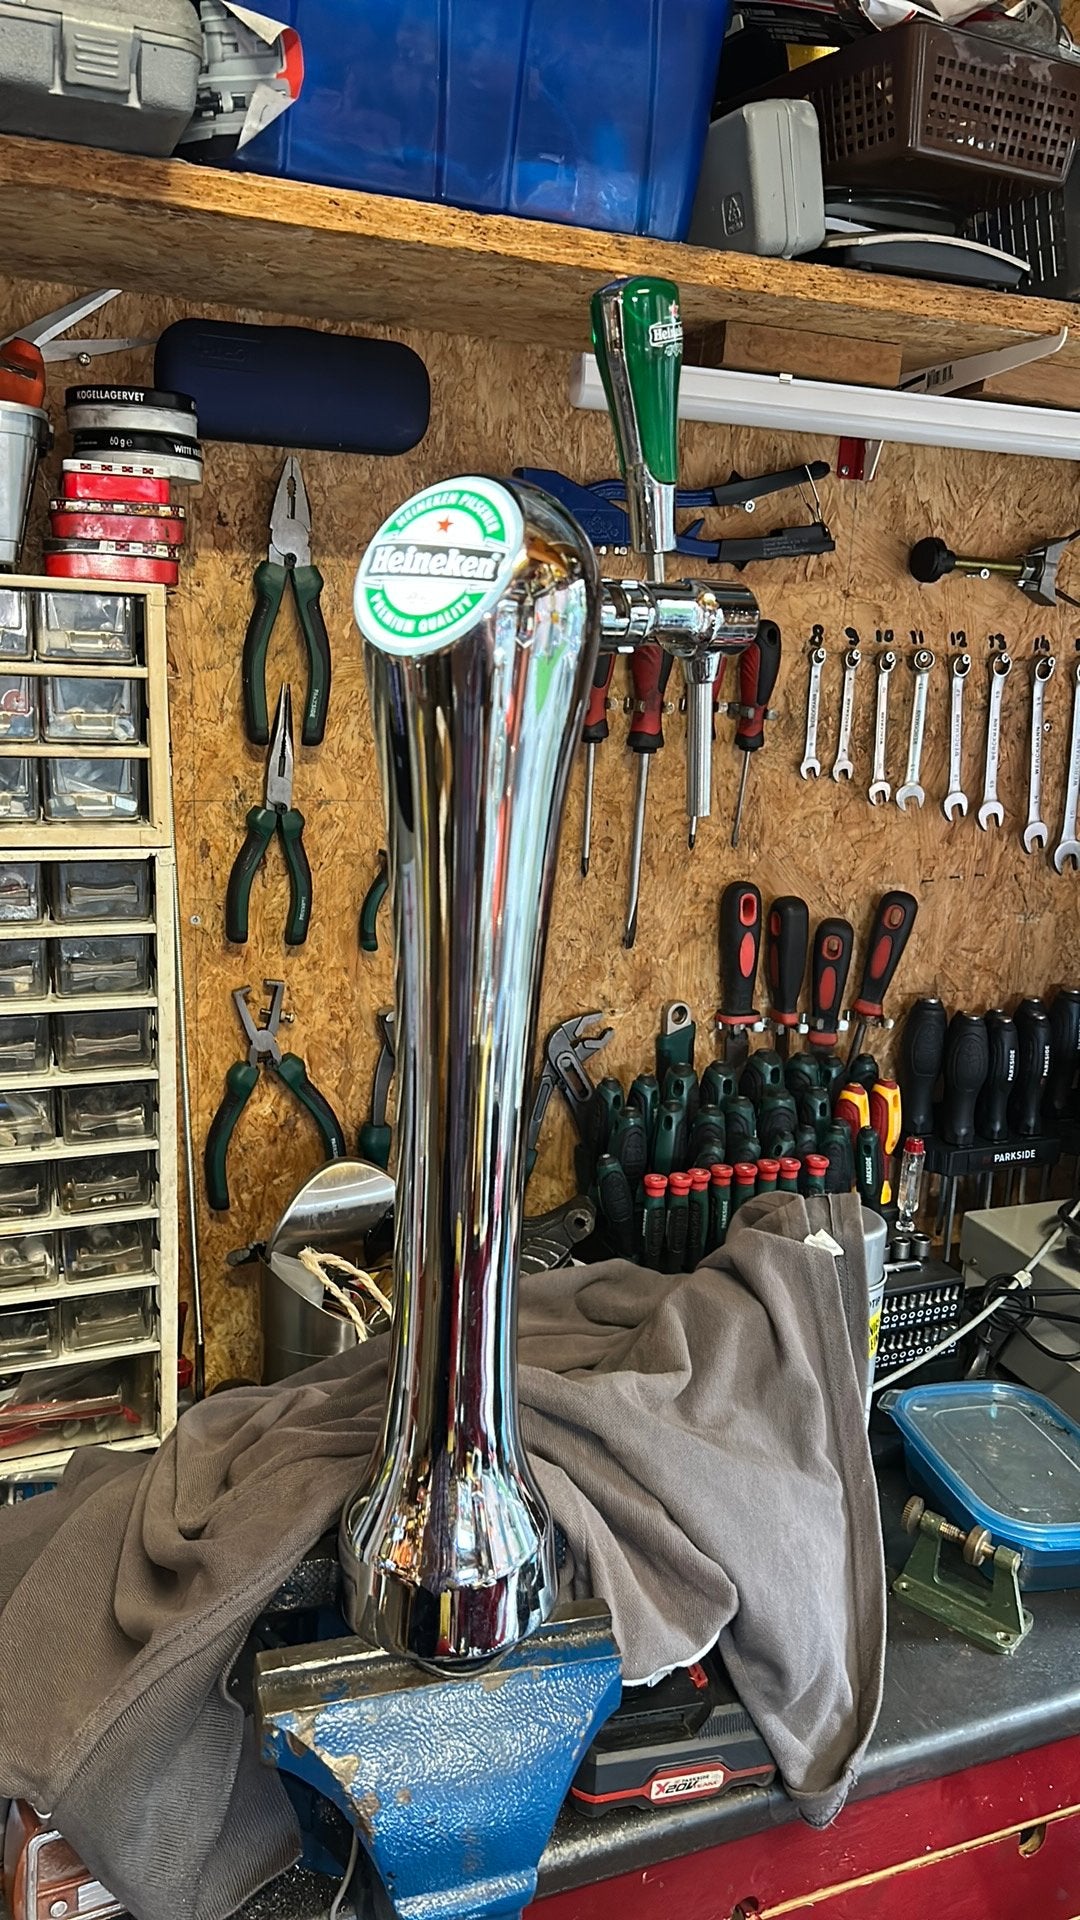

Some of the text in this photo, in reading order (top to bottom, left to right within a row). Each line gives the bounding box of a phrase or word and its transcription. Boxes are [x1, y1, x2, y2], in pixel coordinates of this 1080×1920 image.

[76, 389, 145, 403] KOGELLAGERVET
[109, 436, 119, 446] 60
[369, 544, 498, 580] Heineken
[369, 591, 474, 634] PREMIUM QUALITY
[809, 624, 825, 647] 8
[844, 627, 860, 646] 9
[875, 629, 895, 643] 10
[909, 630, 924, 645] 11
[950, 631, 967, 648] 12
[988, 633, 1007, 650] 13
[1034, 634, 1050, 651] 14
[991, 718, 999, 761] WERCKMANN
[1034, 725, 1042, 774] WERCKMANN
[1007, 1049, 1015, 1082] PARKSIDE
[994, 1149, 1036, 1163] PARKSIDE
[721, 1200, 729, 1230] PARKSIDE
[655, 1781, 698, 1795] X20V
